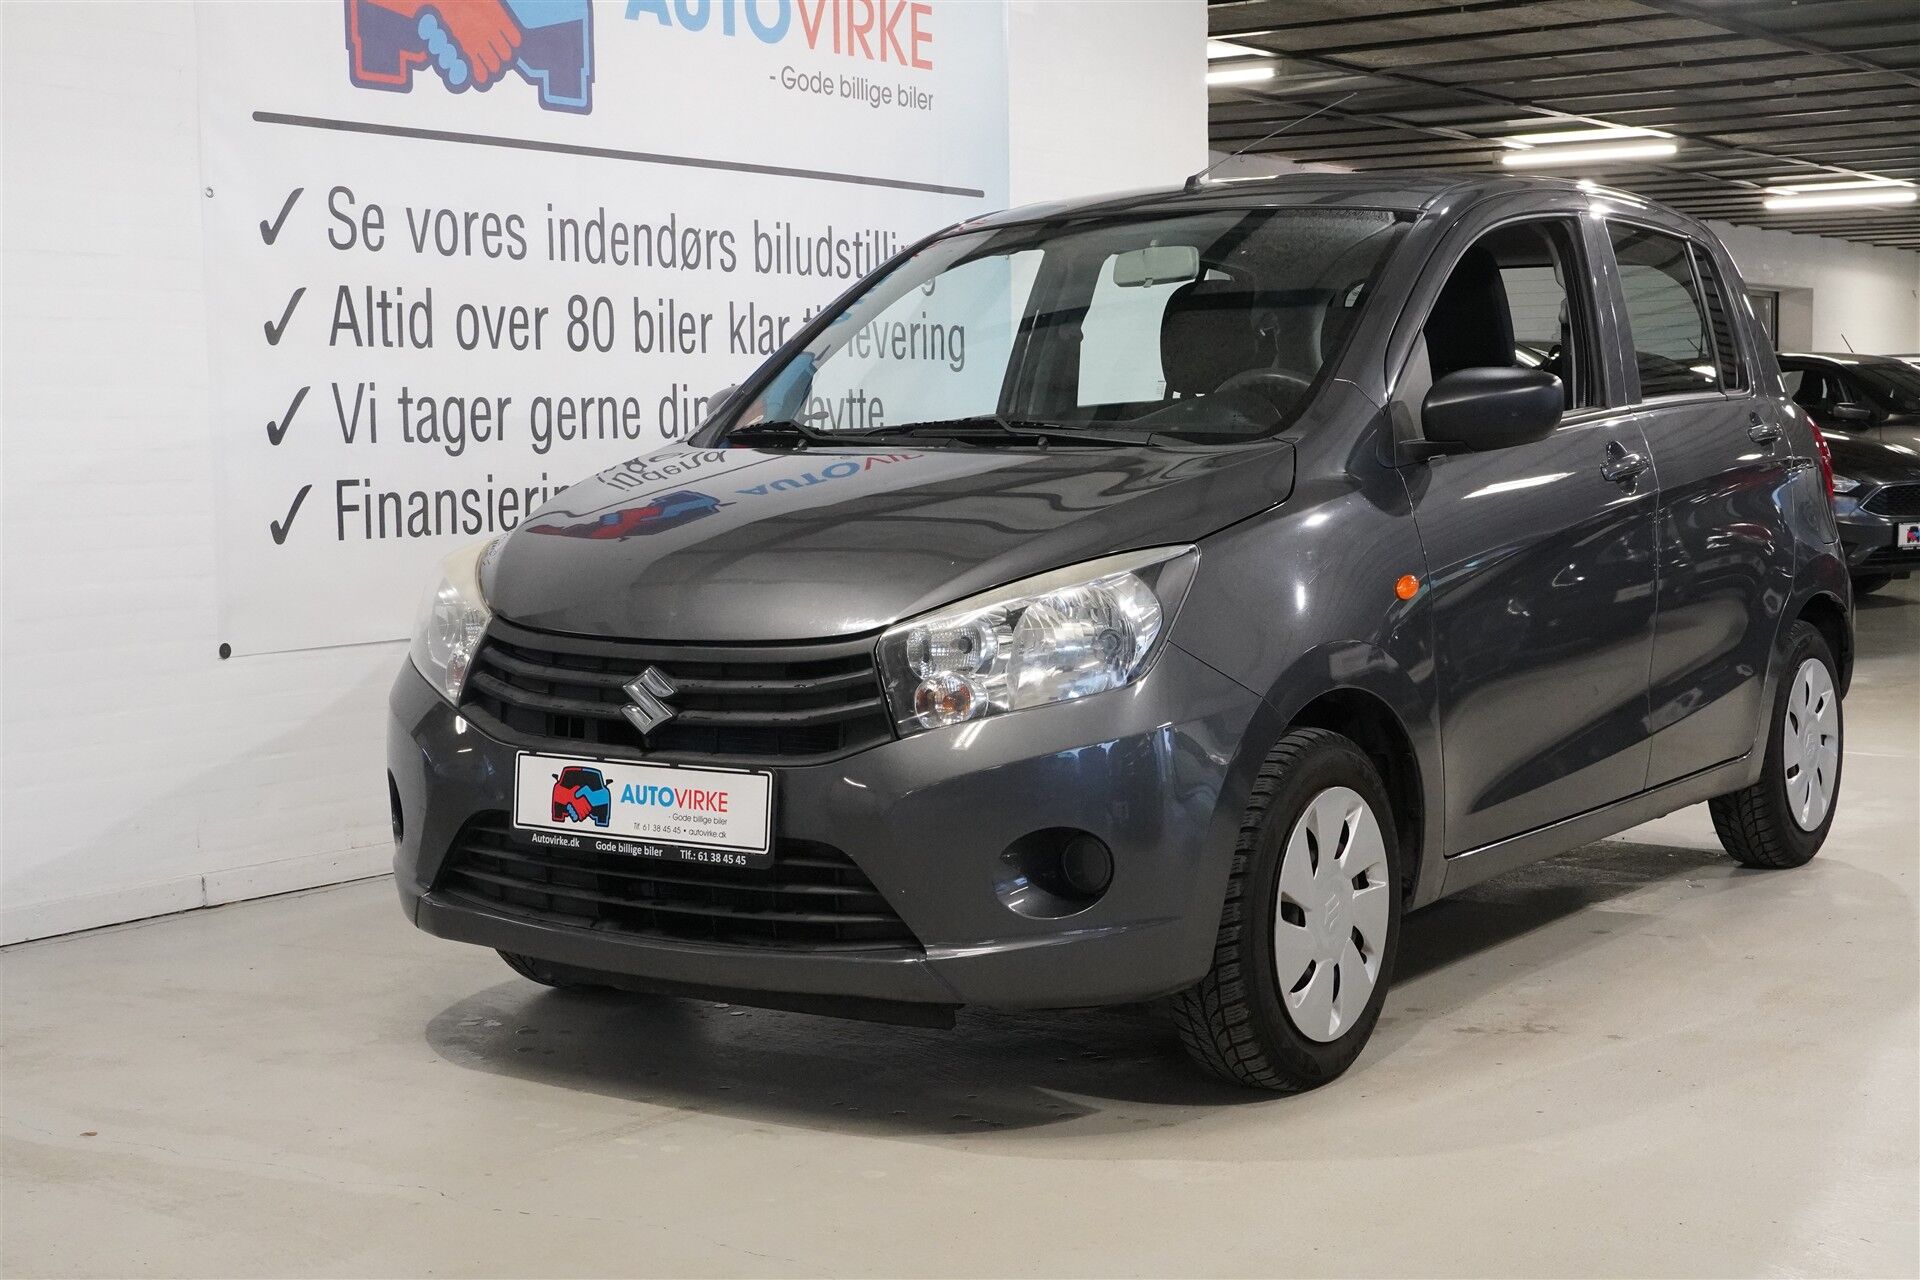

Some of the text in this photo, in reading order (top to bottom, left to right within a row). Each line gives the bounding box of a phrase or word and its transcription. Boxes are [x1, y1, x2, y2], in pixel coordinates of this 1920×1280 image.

[781, 65, 834, 95] Gode
[840, 75, 892, 109] billige
[897, 84, 933, 110] biler
[328, 186, 384, 251] Se
[405, 207, 527, 260] vores
[547, 203, 737, 274] indendørs
[329, 285, 433, 349] Altid
[456, 303, 549, 351] over
[566, 294, 615, 353] 80
[634, 296, 713, 354] biler
[729, 300, 791, 355] klar
[332, 382, 377, 444] Vi
[397, 386, 512, 457] tager
[530, 396, 641, 455] gerne
[620, 783, 728, 812] AUTOVIRKE
[642, 823, 650, 832] 61
[652, 823, 661, 833] 38
[662, 825, 671, 834] 45
[672, 826, 682, 835] 45
[688, 827, 727, 839] autovirke.dk
[672, 812, 728, 826] Gode billige biler
[531, 833, 747, 866] Autovirke.dk Gode billige biler Tlf.: 61 38 45 45
